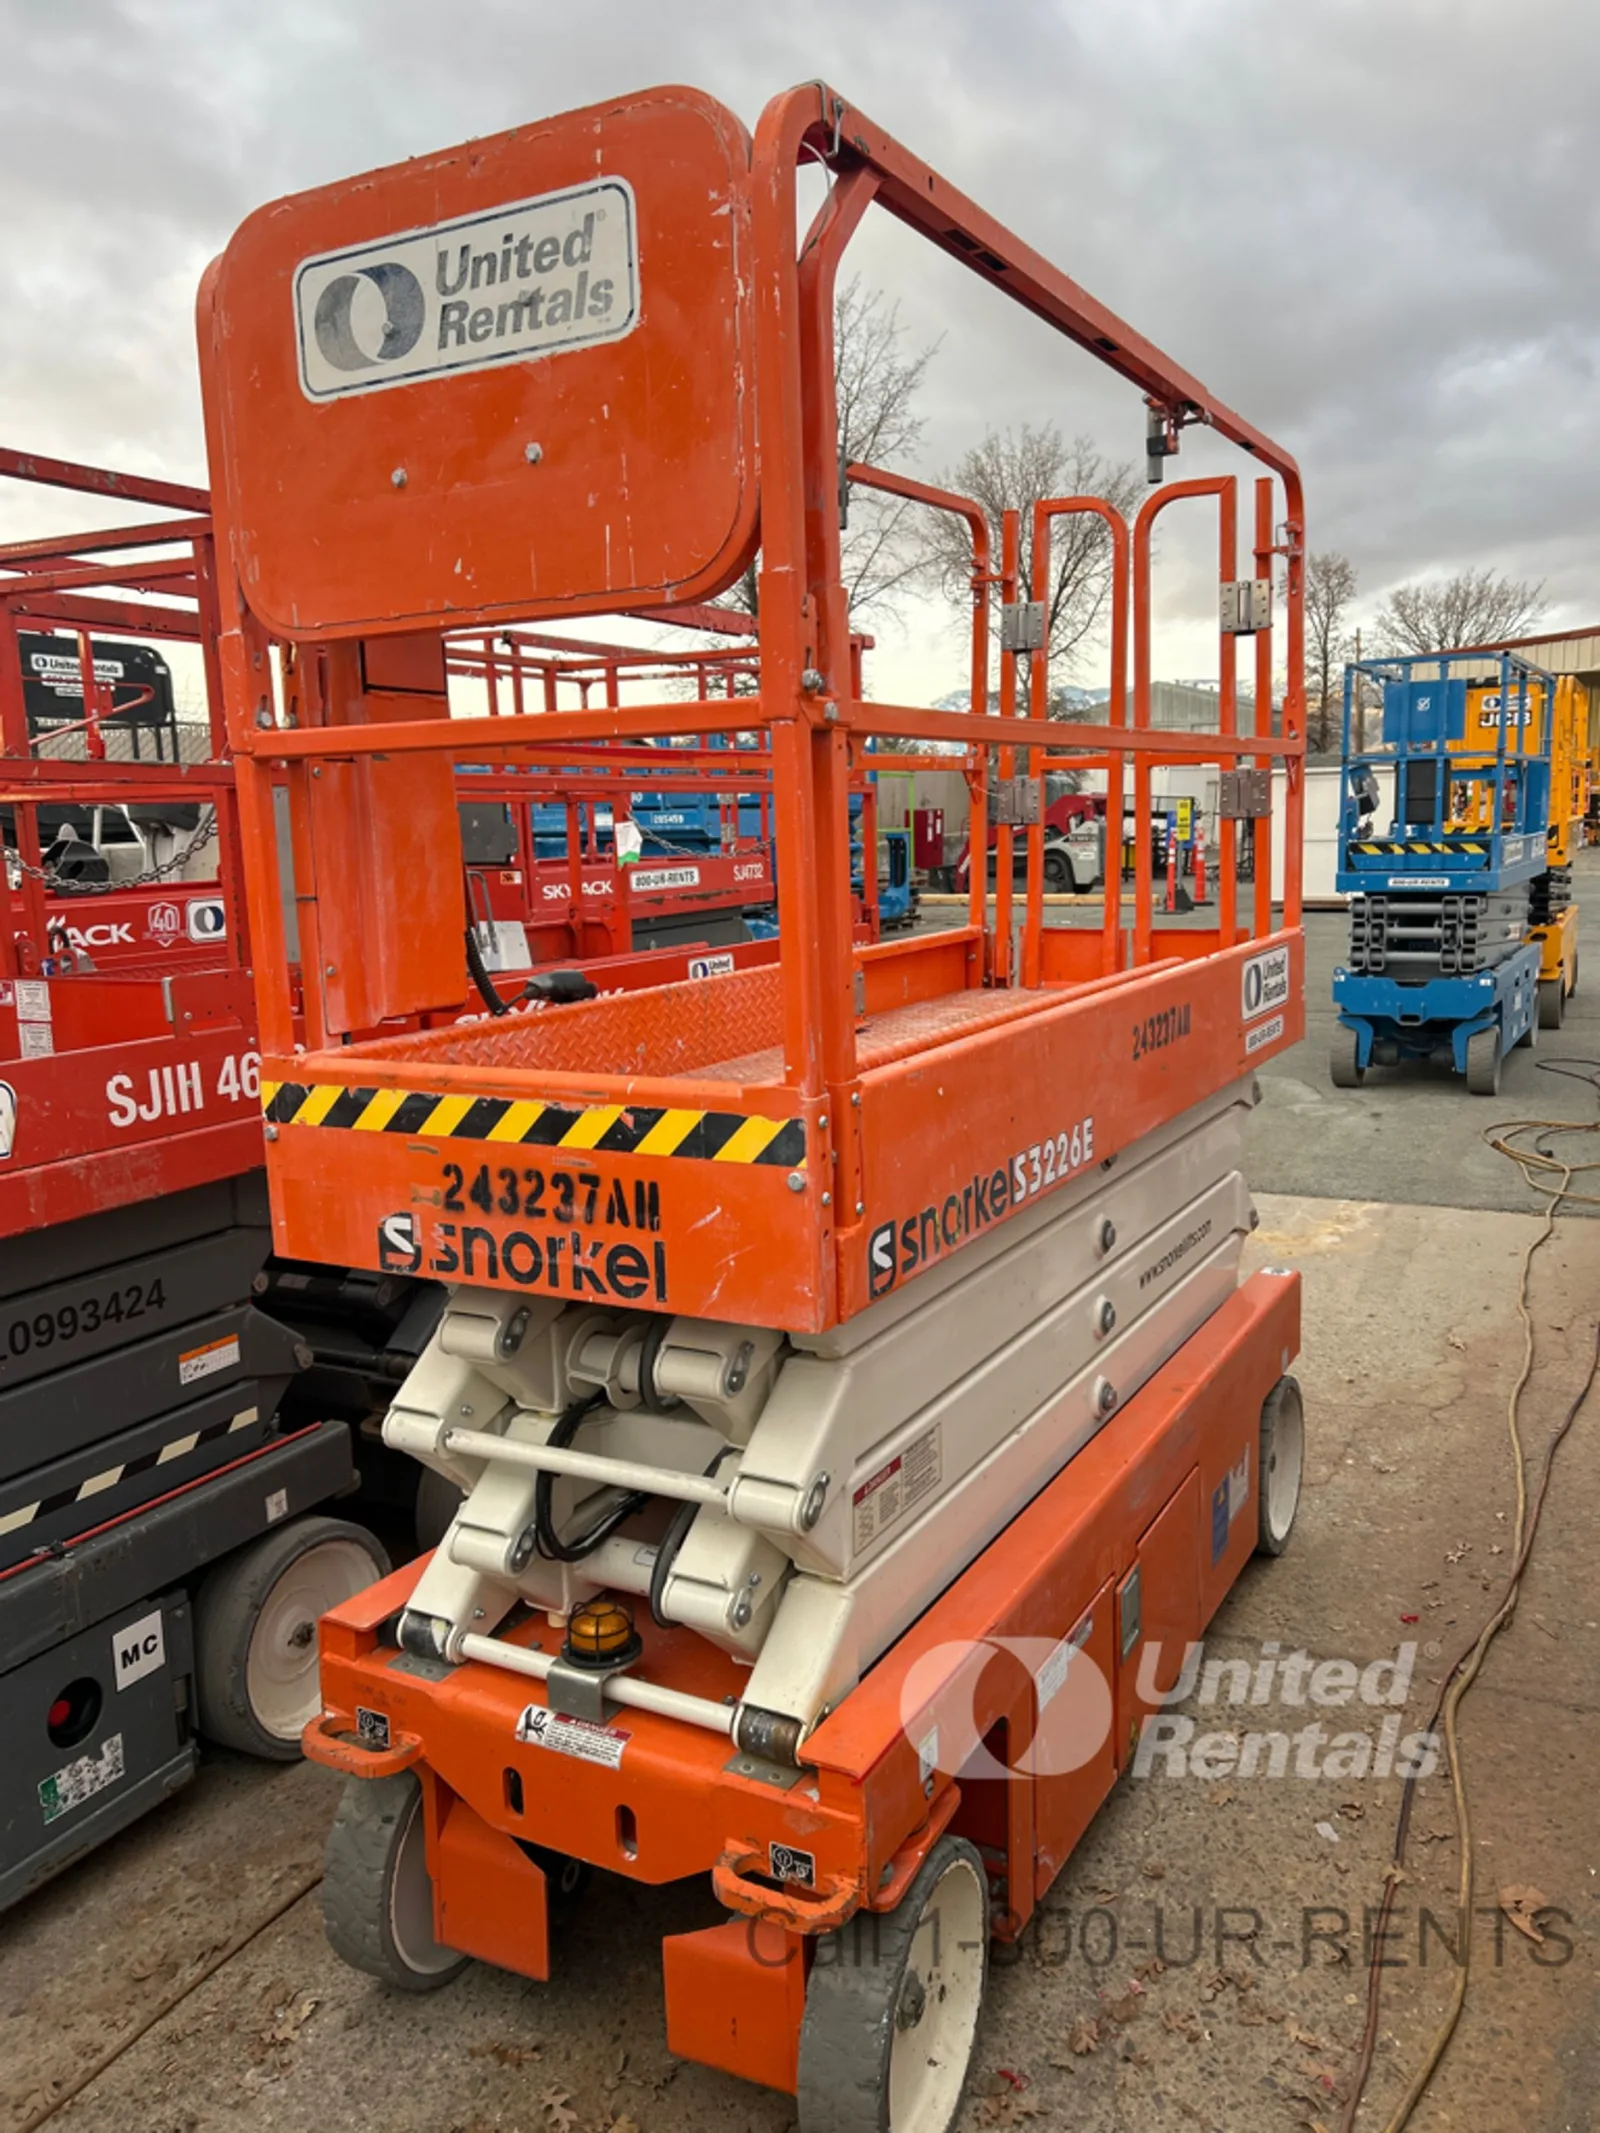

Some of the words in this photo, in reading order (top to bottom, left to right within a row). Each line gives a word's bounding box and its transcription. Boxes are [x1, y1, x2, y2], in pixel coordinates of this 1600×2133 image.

[435, 211, 595, 297] United
[437, 270, 615, 350] Rentals
[542, 880, 614, 899] SKACK
[901, 1158, 1014, 1276] snorkel
[429, 1222, 668, 1303] snorkel
[0, 1278, 166, 1361] 0993424
[121, 1634, 158, 1669] MC
